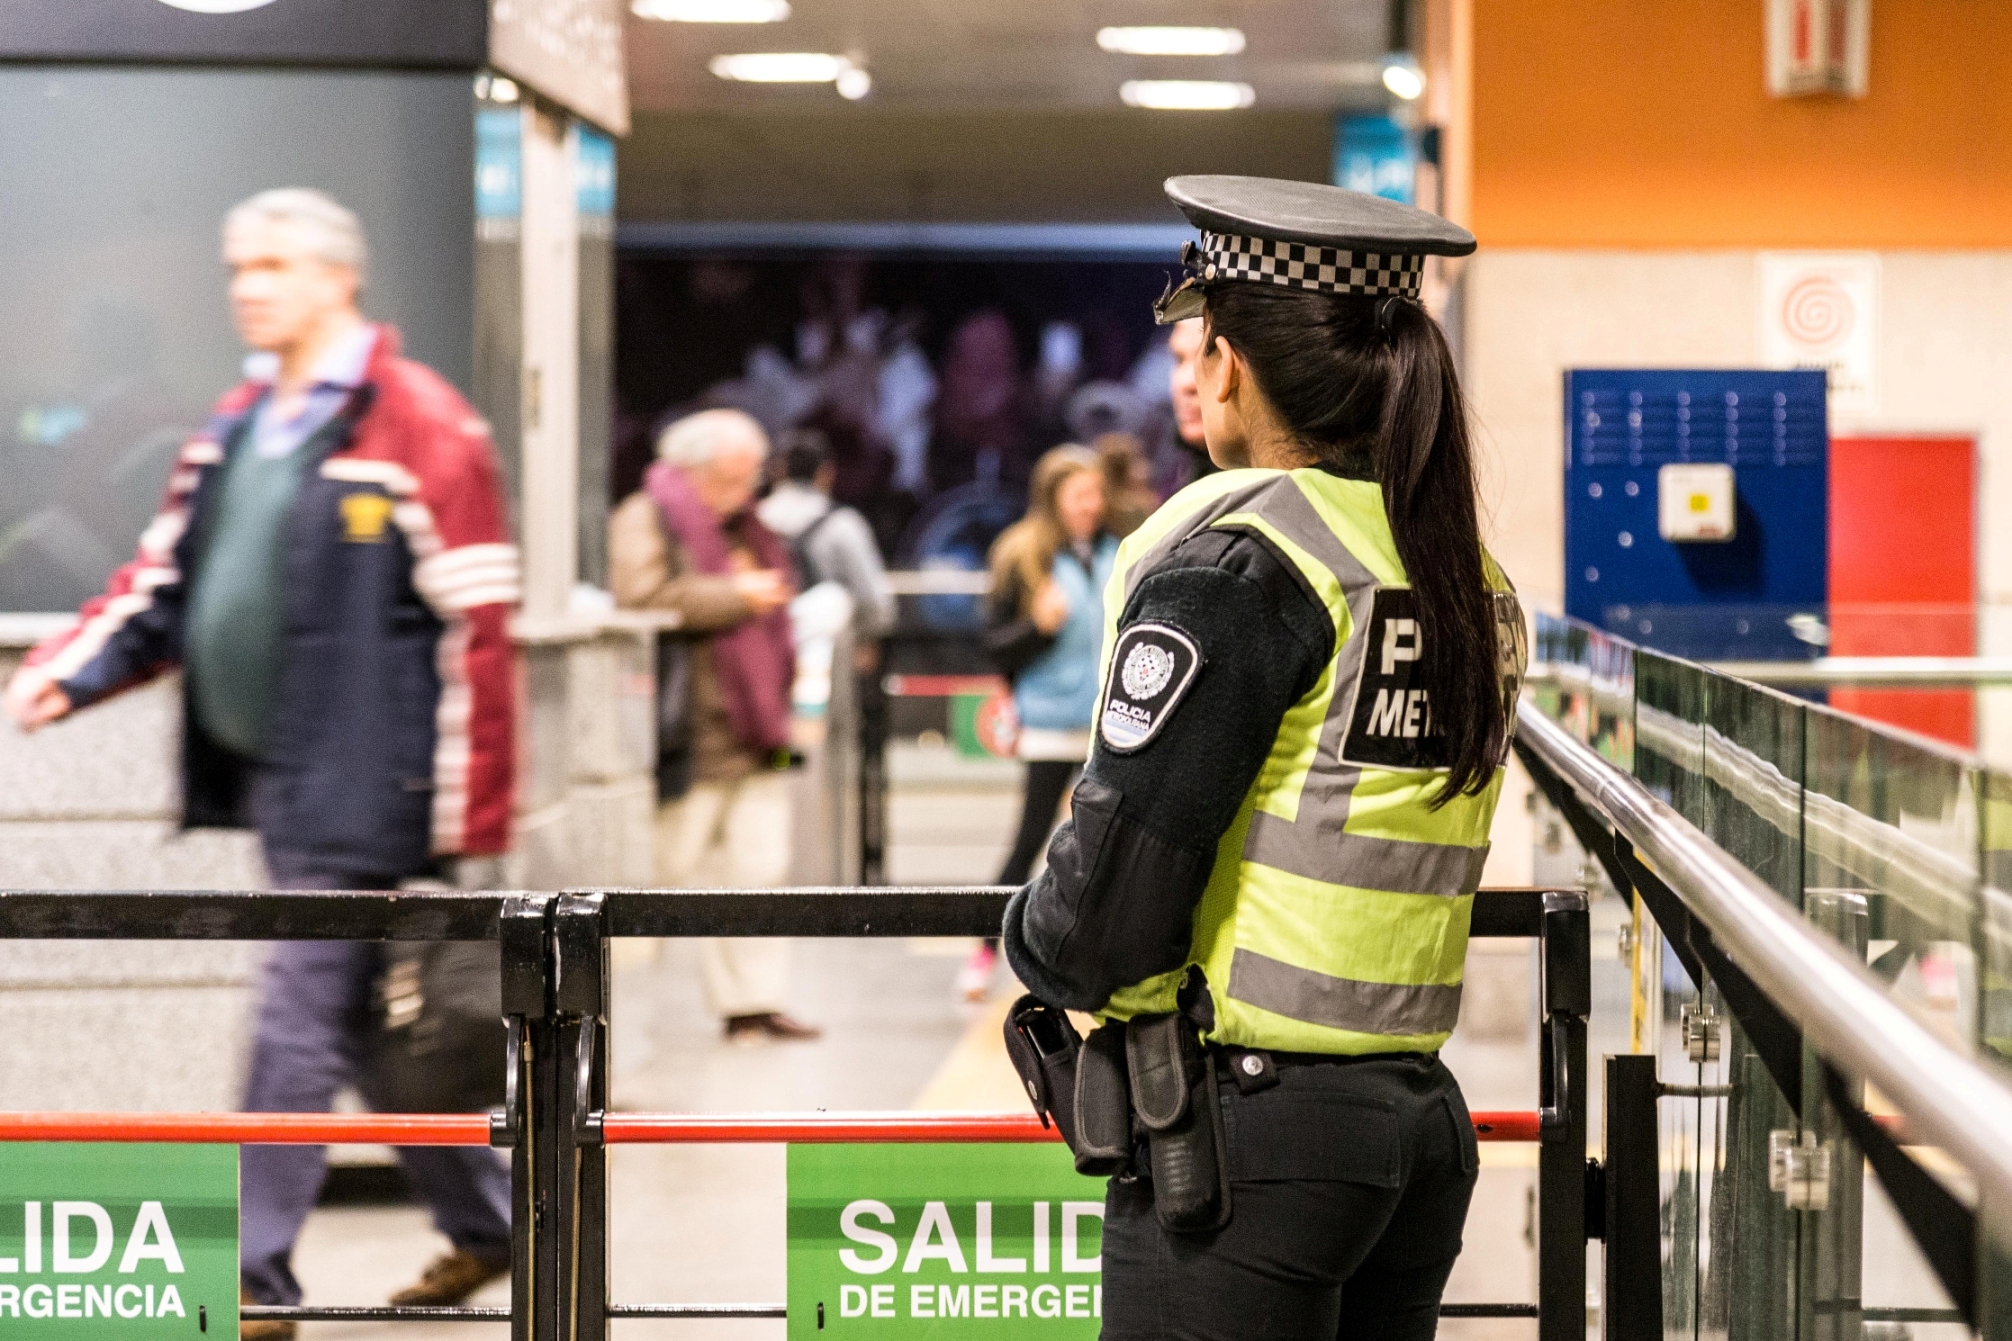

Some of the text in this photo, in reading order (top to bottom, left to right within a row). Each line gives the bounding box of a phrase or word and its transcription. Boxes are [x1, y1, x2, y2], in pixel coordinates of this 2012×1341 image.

[1109, 698, 1151, 723] POLICIA
[838, 1199, 1106, 1275] SALID
[0, 1283, 187, 1319] RGENCIA
[839, 1284, 896, 1318] DE
